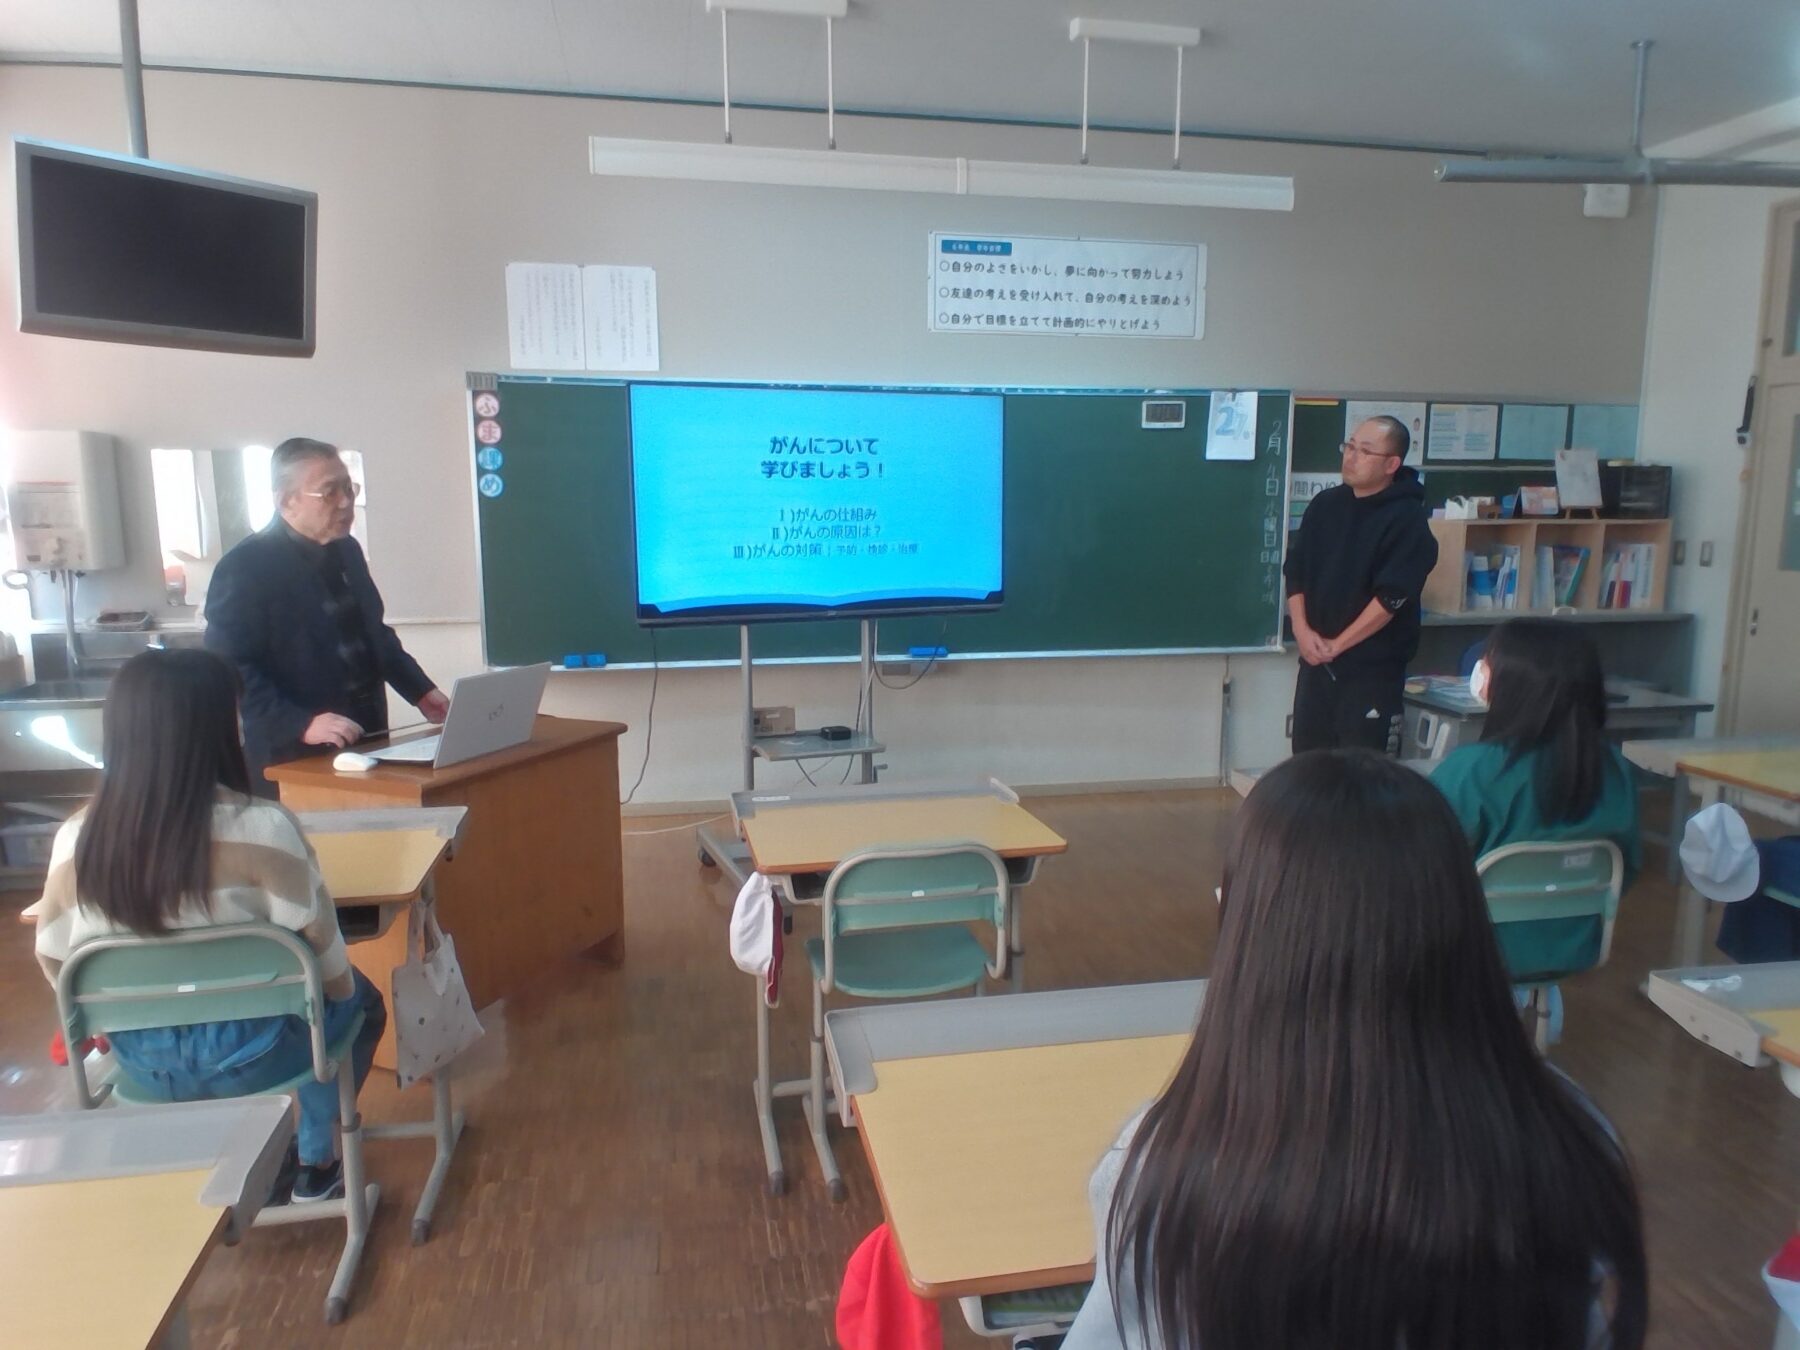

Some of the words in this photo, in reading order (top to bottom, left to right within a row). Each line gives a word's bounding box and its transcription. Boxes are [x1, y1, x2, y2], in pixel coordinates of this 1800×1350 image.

[769, 436, 880, 455] がんについて
[761, 460, 883, 479] 学びましょう！
